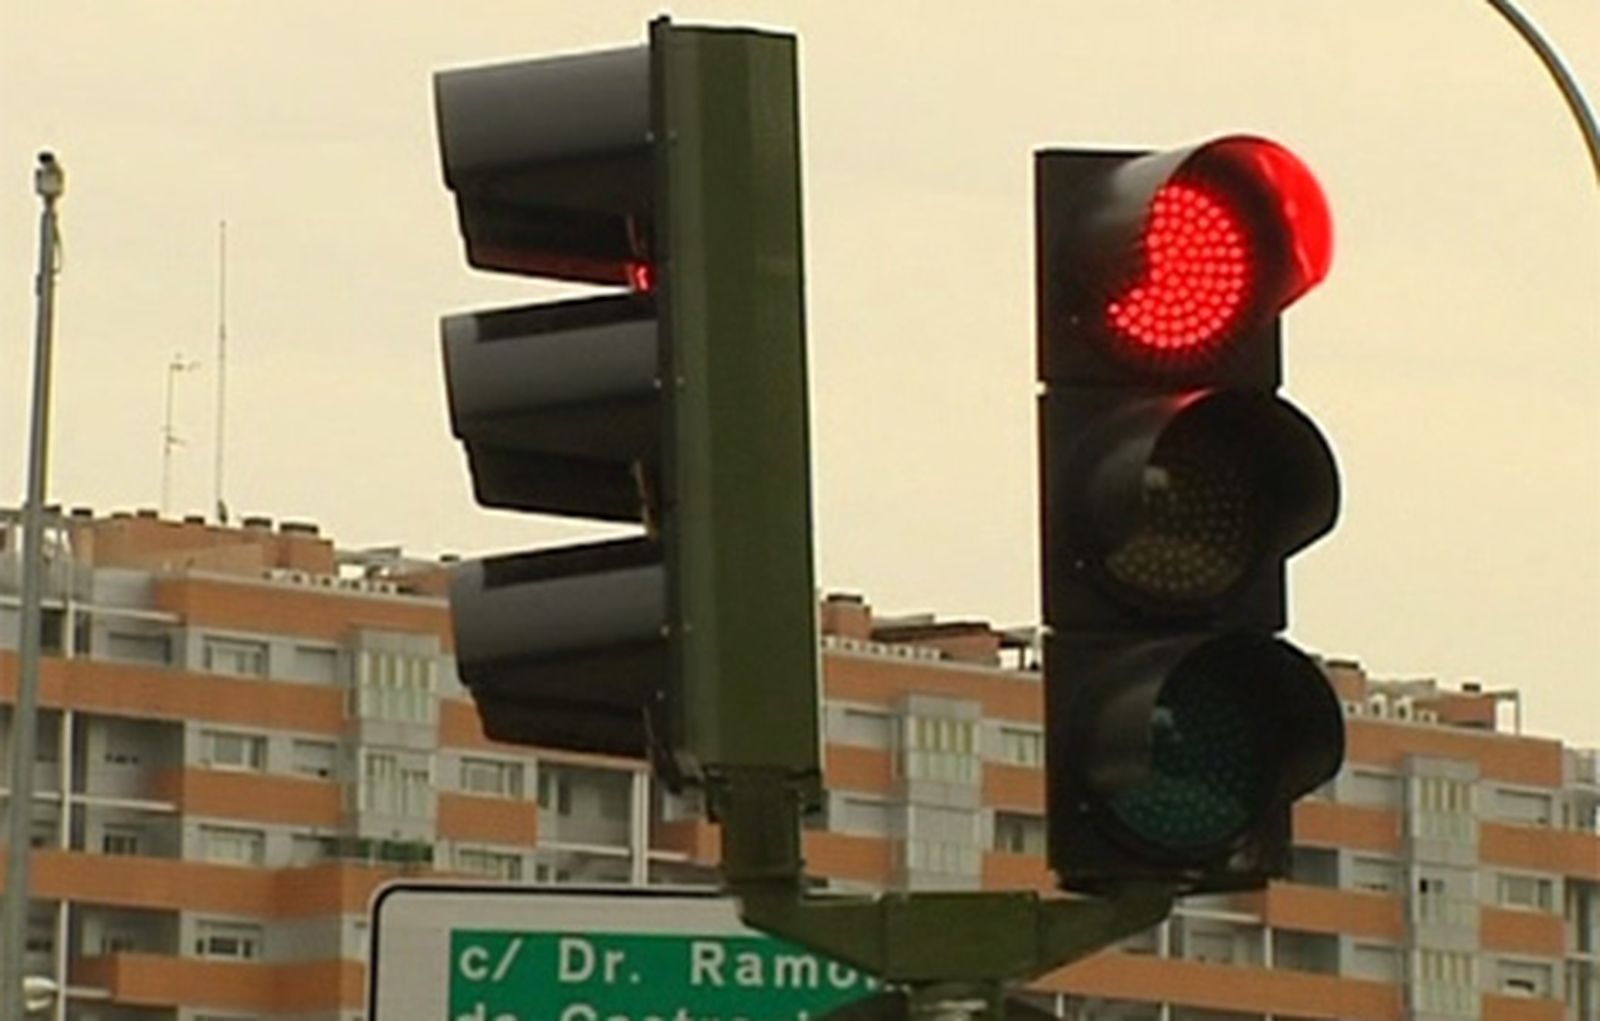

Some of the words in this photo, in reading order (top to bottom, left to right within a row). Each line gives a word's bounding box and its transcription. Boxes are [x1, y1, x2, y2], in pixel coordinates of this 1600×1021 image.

[459, 937, 523, 982] c/
[558, 937, 641, 984] Dr.
[690, 941, 876, 990] Ramo
